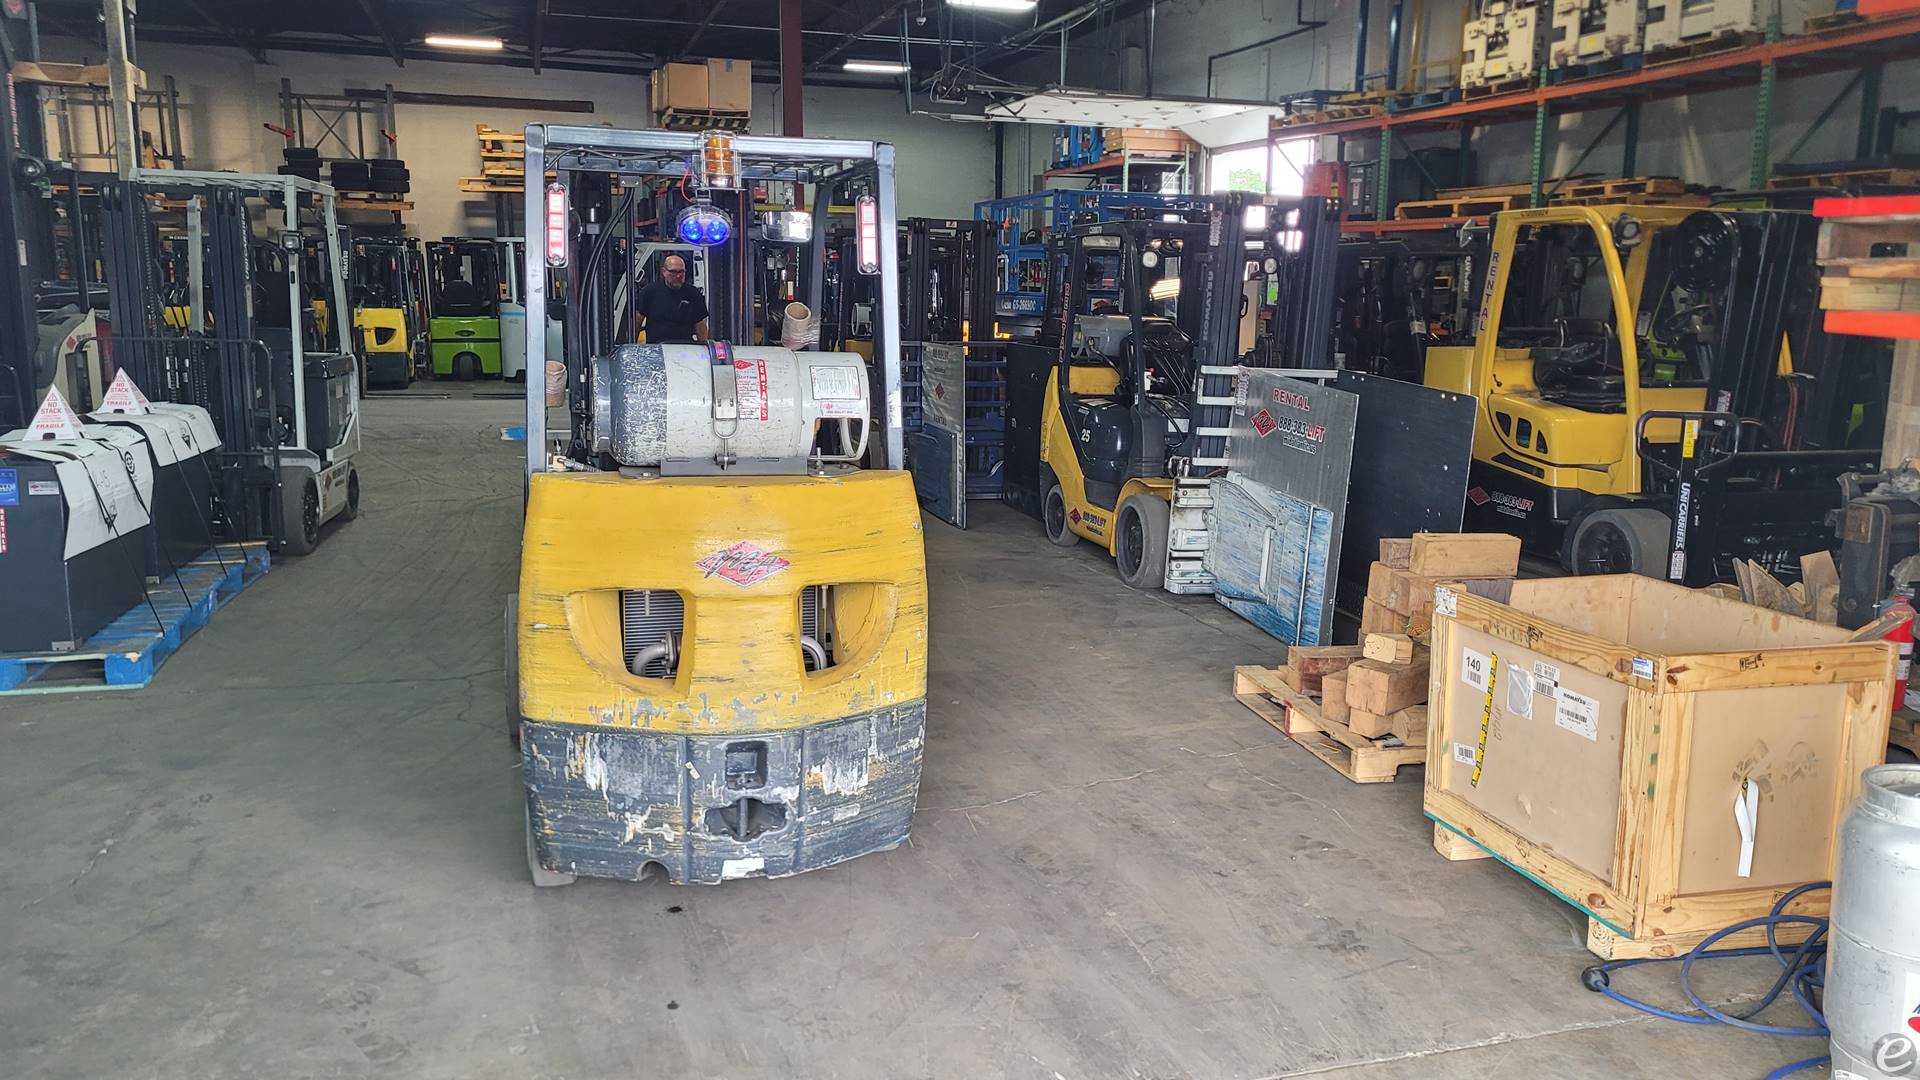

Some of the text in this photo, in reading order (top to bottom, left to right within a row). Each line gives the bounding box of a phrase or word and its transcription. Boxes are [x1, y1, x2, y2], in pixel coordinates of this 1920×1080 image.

[1479, 251, 1500, 331] RENTAL
[1202, 271, 1214, 341] KOMATSU
[1058, 282, 1071, 363] RENTAL
[1273, 388, 1310, 411] RENTAL
[1080, 428, 1091, 443] 25
[1466, 656, 1481, 672] 140
[1563, 692, 1587, 706] KOMATSU
